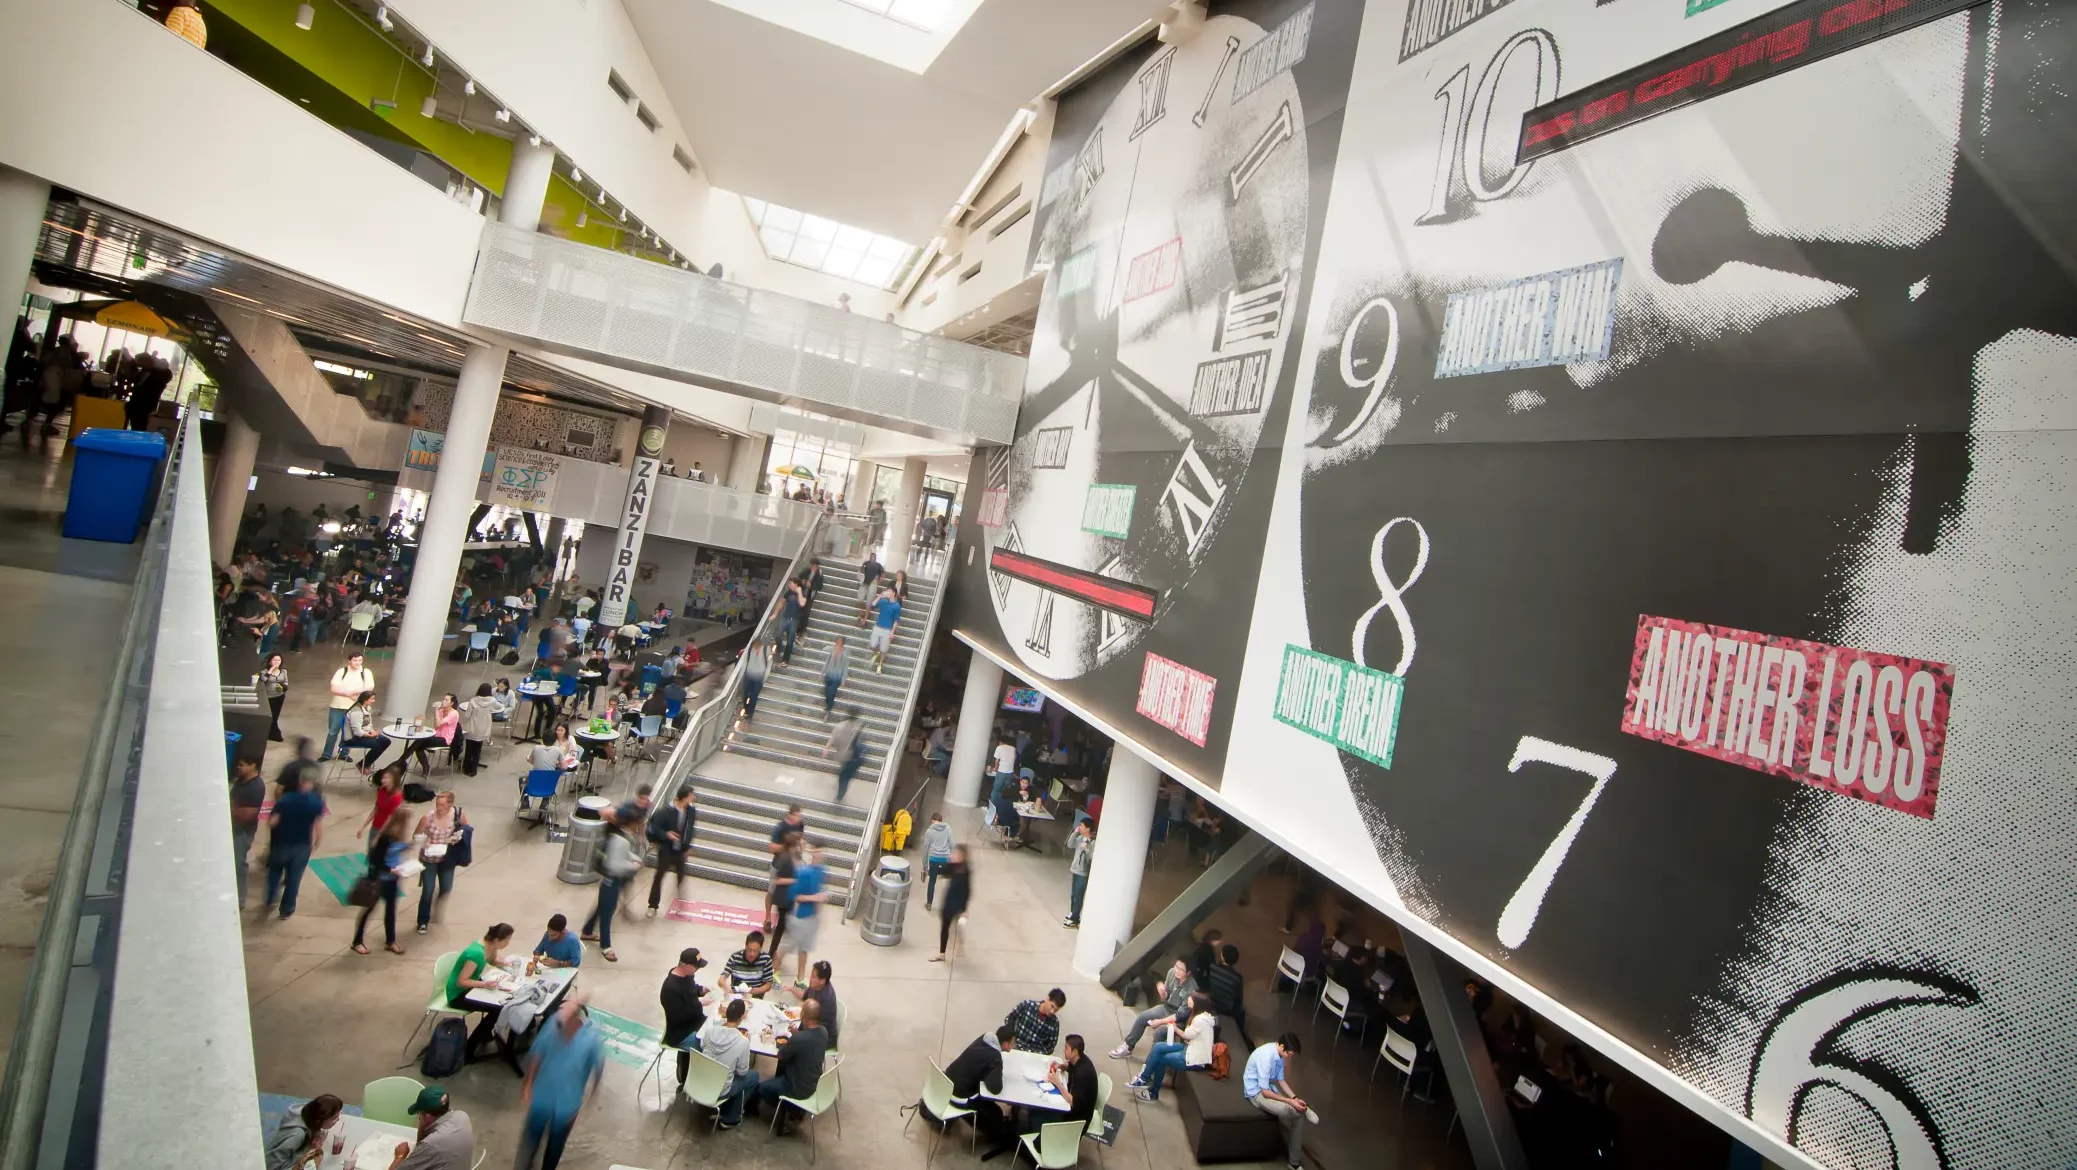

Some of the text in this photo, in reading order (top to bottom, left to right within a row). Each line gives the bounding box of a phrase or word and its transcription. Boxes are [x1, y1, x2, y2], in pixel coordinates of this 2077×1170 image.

[1414, 27, 1562, 226] 10
[1189, 354, 1267, 416] ANOTHER IDEA
[1333, 298, 1400, 442] 9
[1441, 266, 1615, 370] ANOTHER WIN
[409, 449, 440, 466] TRIT
[608, 460, 653, 603] ZANZIBAR
[1352, 516, 1431, 678] 8
[1139, 657, 1213, 740] ANOTHER TIME
[1277, 650, 1399, 760] ANOTHER DREAM
[1633, 627, 1936, 802] ANOTHER LOSS
[1497, 735, 1618, 950] 7
[1745, 960, 1981, 1170] 6
